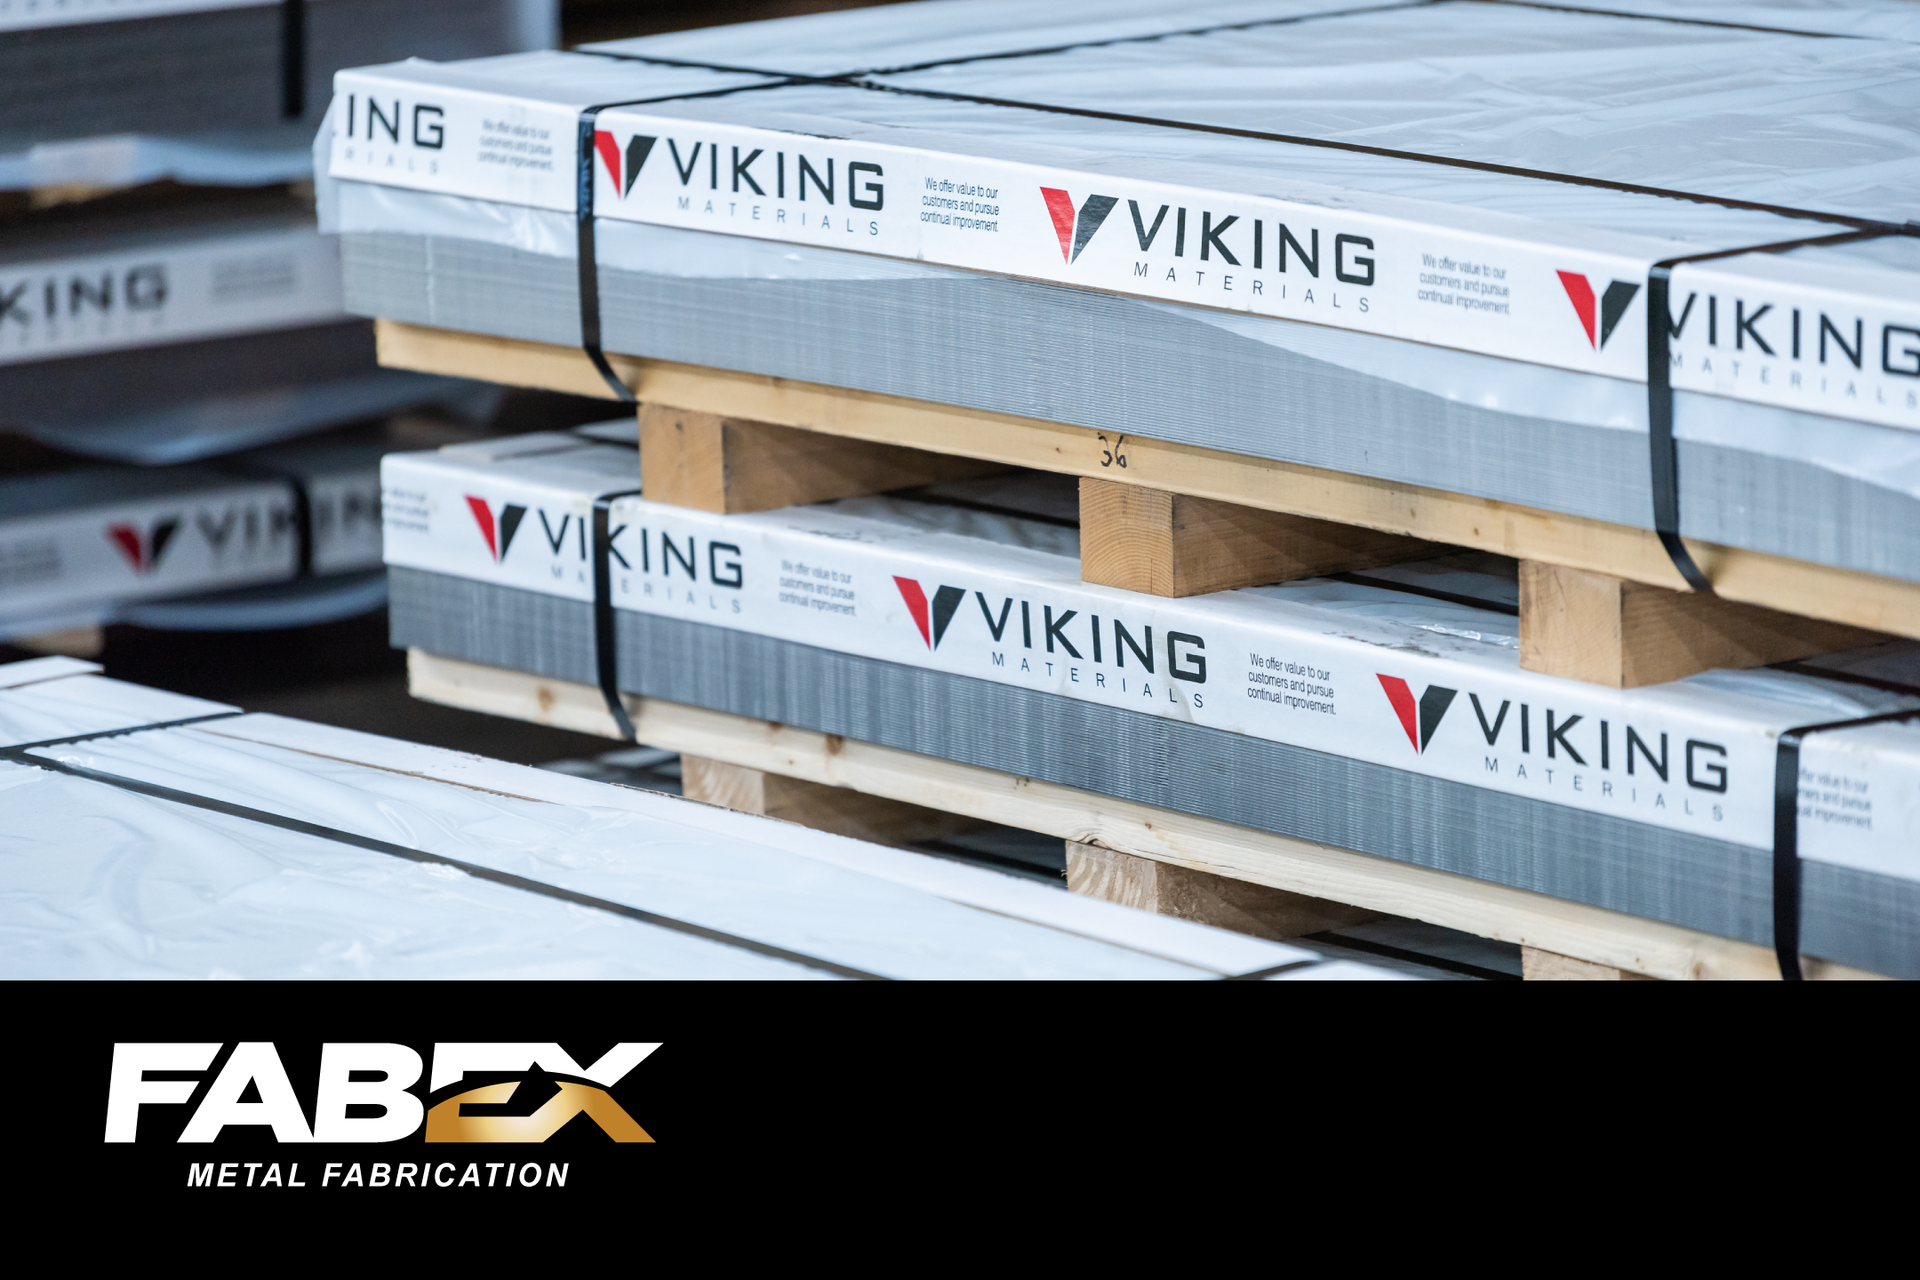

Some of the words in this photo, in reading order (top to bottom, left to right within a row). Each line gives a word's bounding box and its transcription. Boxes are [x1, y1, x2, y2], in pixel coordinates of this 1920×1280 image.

[666, 136, 886, 212] VIKING
[925, 177, 937, 191] We
[939, 179, 955, 193] offer
[956, 182, 976, 196] value
[977, 185, 984, 197] to
[986, 188, 998, 199] our
[677, 196, 880, 236] MATERIALS
[920, 211, 951, 226] continual
[953, 213, 999, 232] improvement.
[922, 195, 958, 210] customers
[960, 199, 974, 212] and
[975, 202, 999, 216] pursue
[1127, 199, 1376, 287] VIKING
[1422, 252, 1436, 268] We
[1439, 256, 1457, 271] offer
[1459, 261, 1481, 276] value
[1482, 264, 1491, 277] to
[1493, 267, 1507, 280] our
[1133, 262, 1370, 313] MATERIALS
[1418, 289, 1454, 305] continual
[1456, 293, 1511, 315] improvement.
[1419, 273, 1462, 290] customers
[1464, 279, 1480, 293] and
[1481, 282, 1510, 298] pursue
[1668, 292, 1920, 378] VIKING
[1097, 432, 1128, 469] 36
[551, 565, 741, 614] MAERIALS
[975, 590, 1208, 684] VIKING
[991, 651, 1205, 709] MATERIALS
[1248, 671, 1288, 689] customers
[1290, 680, 1305, 693] and
[1307, 683, 1334, 698] pursue
[1249, 652, 1264, 667] We
[1265, 656, 1283, 671] offer
[1284, 661, 1306, 676] value
[1307, 665, 1315, 678] to
[1317, 669, 1330, 681] our
[1247, 687, 1282, 704] continual
[1284, 692, 1336, 715] improvement.
[1468, 692, 1729, 794] VIKING
[1485, 756, 1724, 822] MATERIALS
